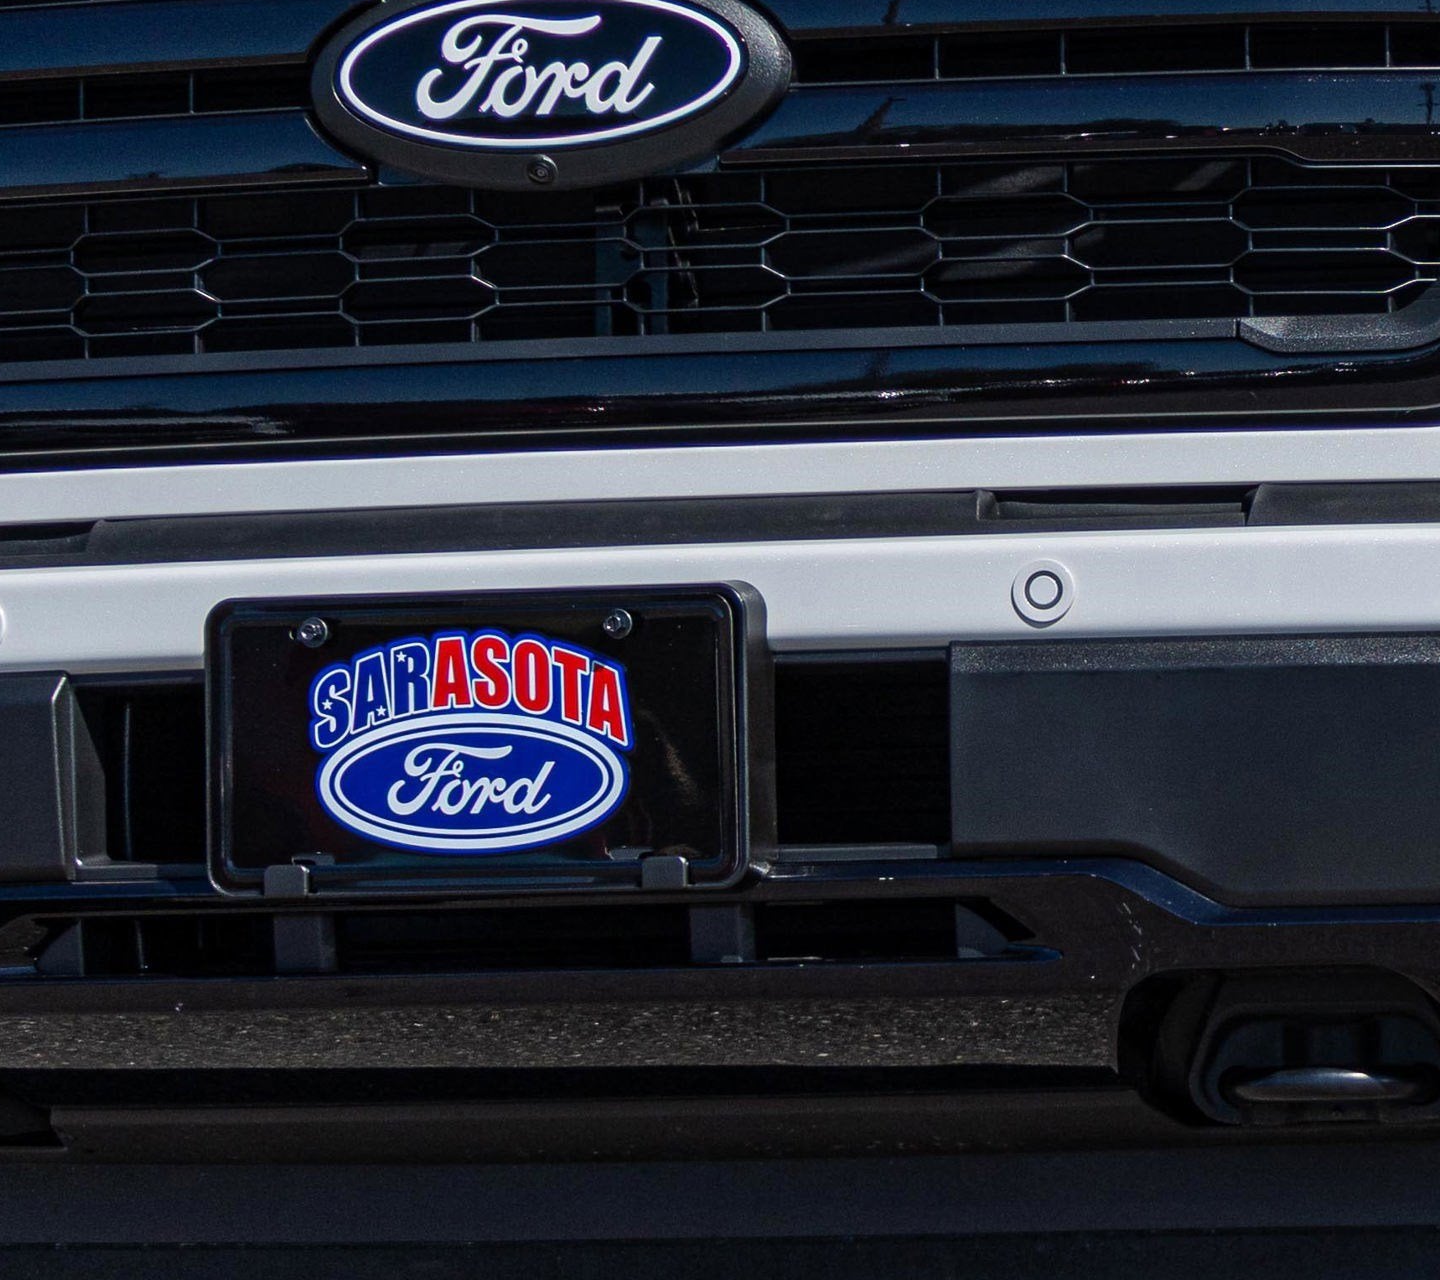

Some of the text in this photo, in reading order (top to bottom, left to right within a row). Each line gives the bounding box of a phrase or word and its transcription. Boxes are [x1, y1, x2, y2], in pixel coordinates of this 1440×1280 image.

[416, 14, 662, 118] Ford
[313, 634, 629, 749] SARASOTA
[387, 742, 555, 816] Ford
